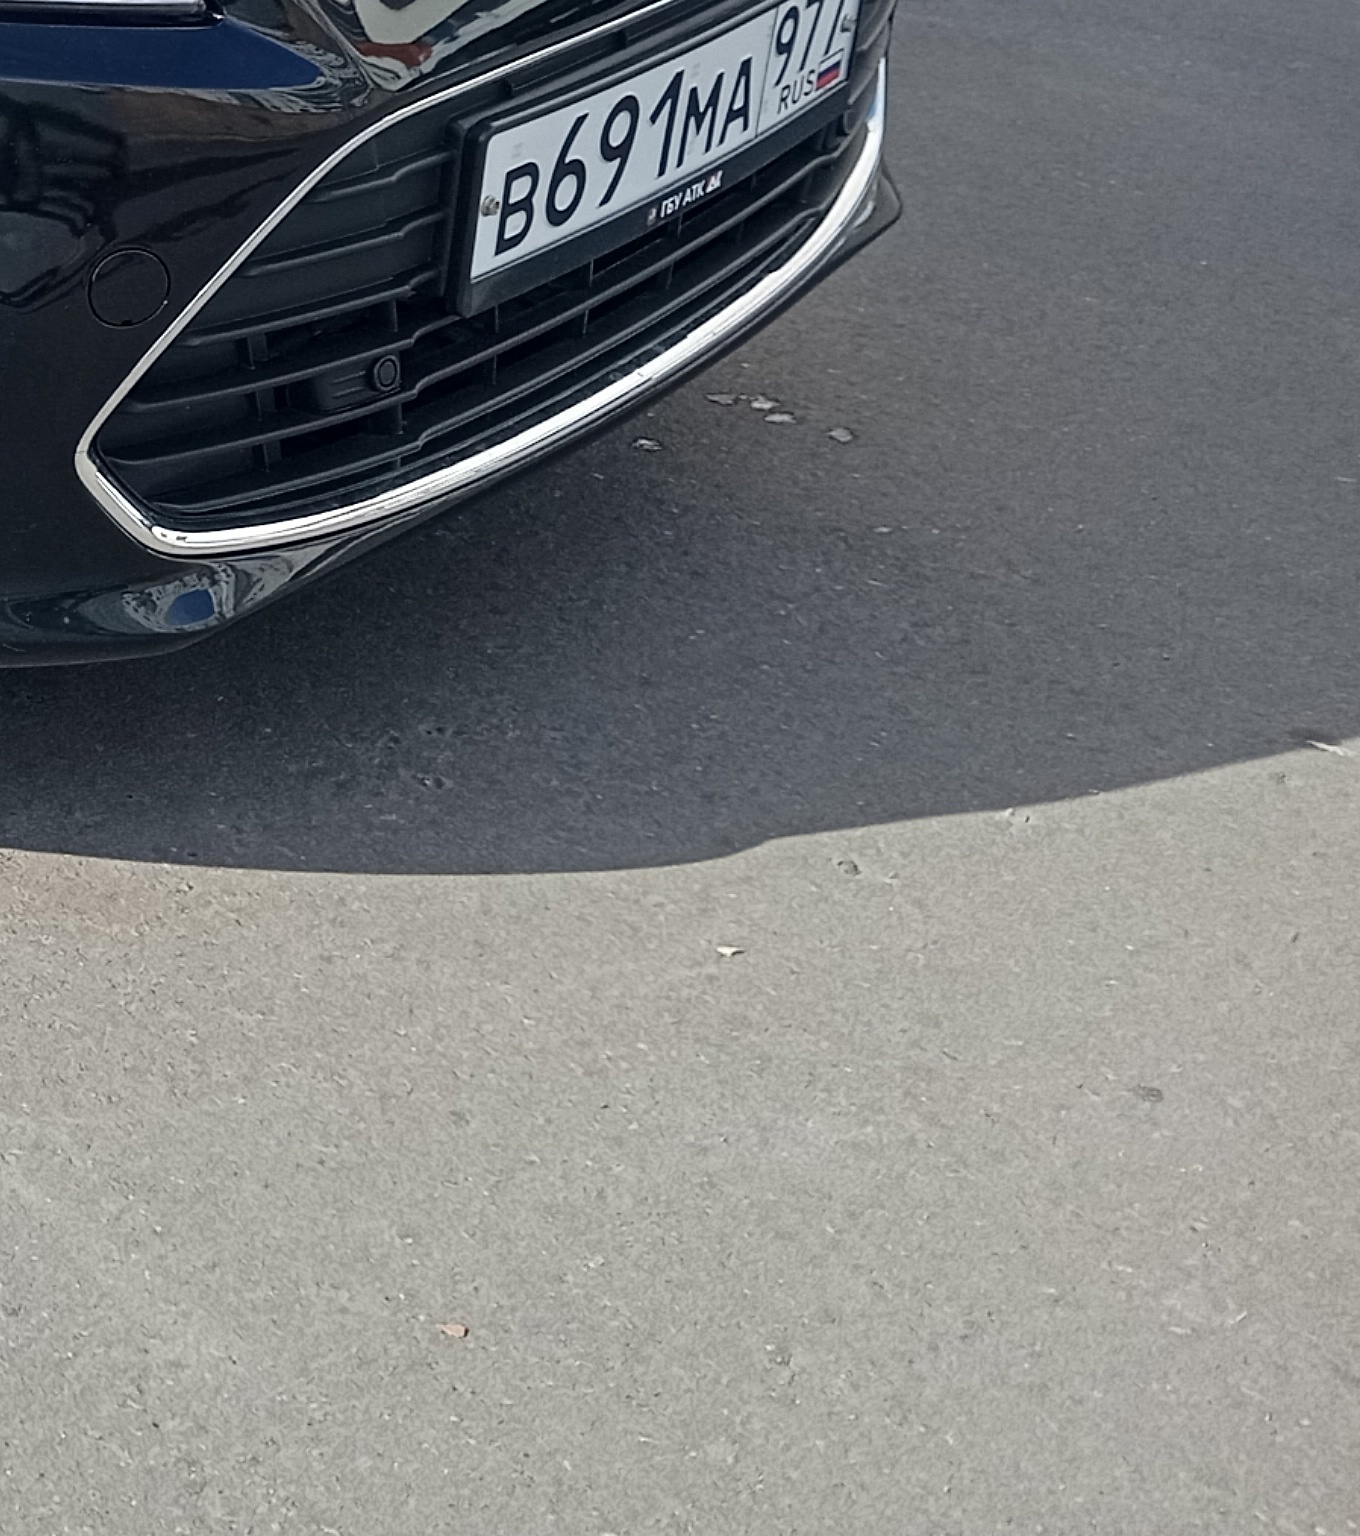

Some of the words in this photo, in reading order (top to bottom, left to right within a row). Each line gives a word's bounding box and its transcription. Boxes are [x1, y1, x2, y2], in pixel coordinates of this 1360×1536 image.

[776, 68, 817, 115] RUS
[494, 56, 754, 257] В691МА
[659, 192, 684, 219] ГБУ
[681, 178, 706, 207] АТК
